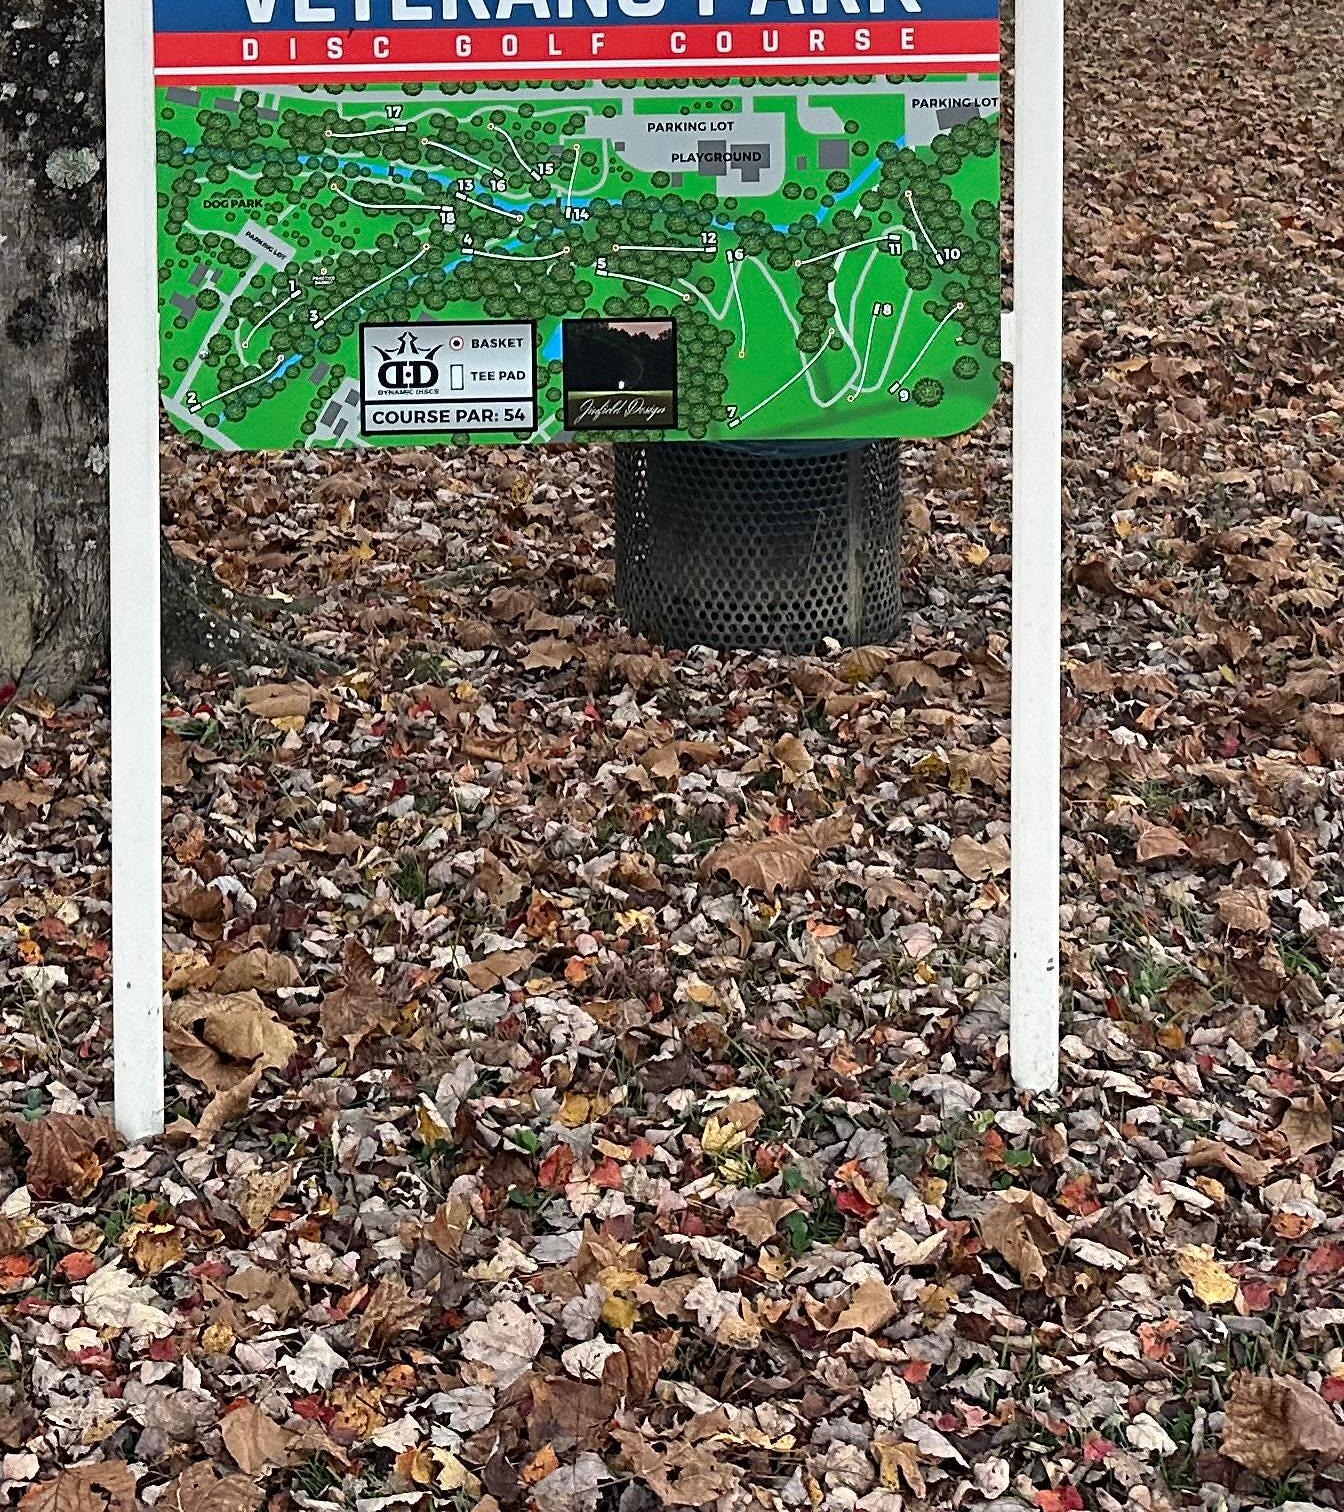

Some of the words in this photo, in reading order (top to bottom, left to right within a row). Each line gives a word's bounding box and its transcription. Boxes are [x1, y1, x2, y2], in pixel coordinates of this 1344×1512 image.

[242, 36, 390, 62] DISC
[455, 33, 606, 58] GOLF
[670, 28, 916, 54] COURSE
[911, 98, 971, 109] PARKING
[974, 97, 999, 107] LOT
[385, 105, 403, 119] 17
[647, 122, 707, 133] PARKING
[710, 121, 735, 131] LOT
[671, 152, 762, 163] PLAYGROUND
[537, 162, 554, 175] 15
[457, 179, 474, 191] 13
[489, 179, 506, 192] 16
[203, 199, 229, 209] DOG
[231, 198, 263, 208] PARK
[439, 212, 456, 224] 18
[572, 208, 590, 220] 14
[463, 233, 473, 245] 4
[701, 232, 717, 244] 12
[888, 243, 902, 255] 11
[943, 247, 961, 260] 10
[597, 257, 607, 269] 5
[288, 280, 296, 292] 1
[309, 309, 319, 321] 3
[471, 338, 523, 349] BASKET
[470, 371, 495, 381] TEE
[499, 370, 526, 381] PAD
[186, 392, 197, 404] 2
[899, 389, 909, 402] 9
[372, 410, 451, 425] COURSE
[455, 408, 499, 424] PAR:
[503, 408, 526, 422] 54
[726, 406, 737, 418] 7
